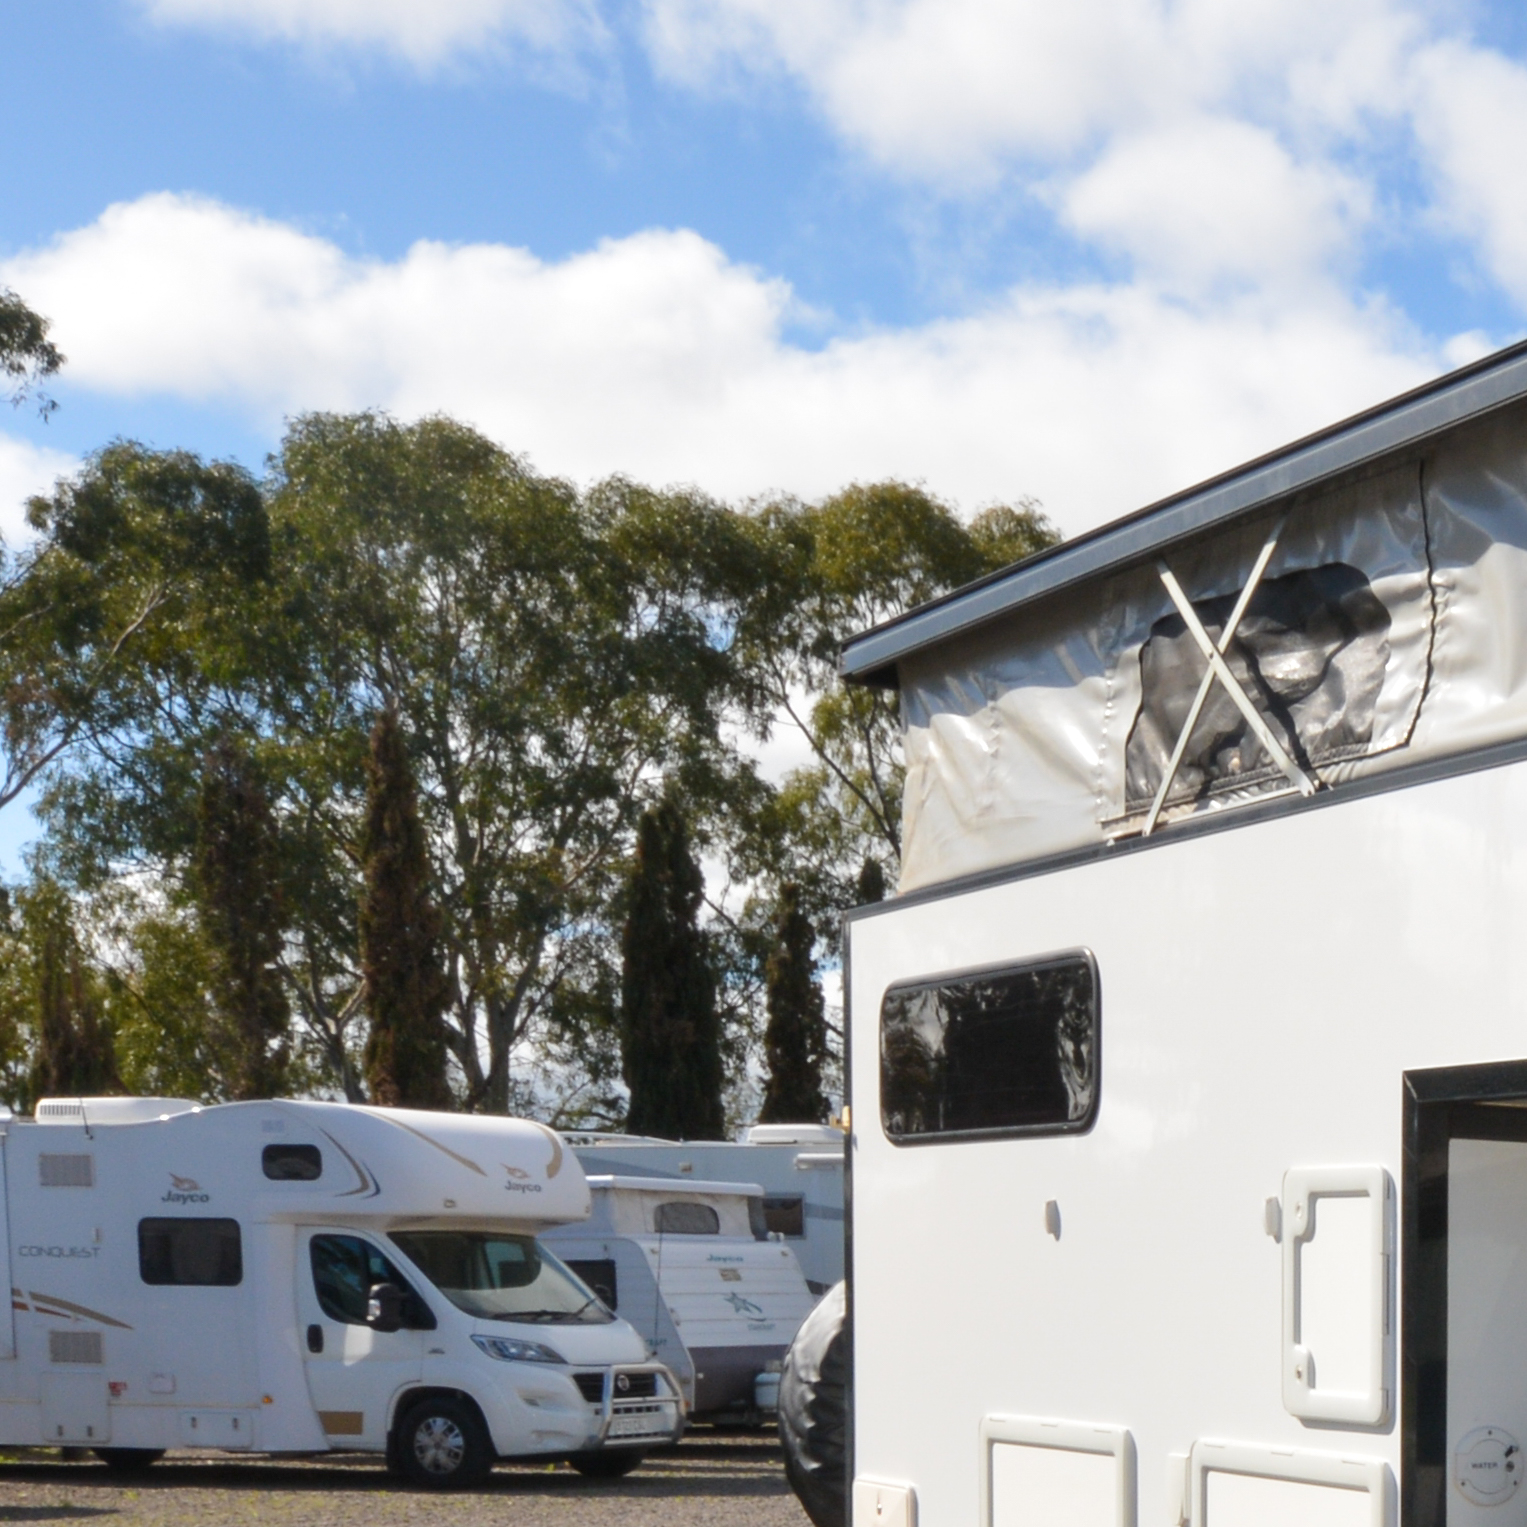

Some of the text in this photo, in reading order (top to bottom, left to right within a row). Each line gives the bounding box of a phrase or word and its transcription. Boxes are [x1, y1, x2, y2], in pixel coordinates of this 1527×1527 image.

[504, 1180, 542, 1194] Jayco
[161, 1190, 210, 1205] Jayco
[18, 1245, 101, 1259] CONQUEST
[706, 1253, 744, 1264] Jayco
[1470, 1461, 1498, 1470] WATER
